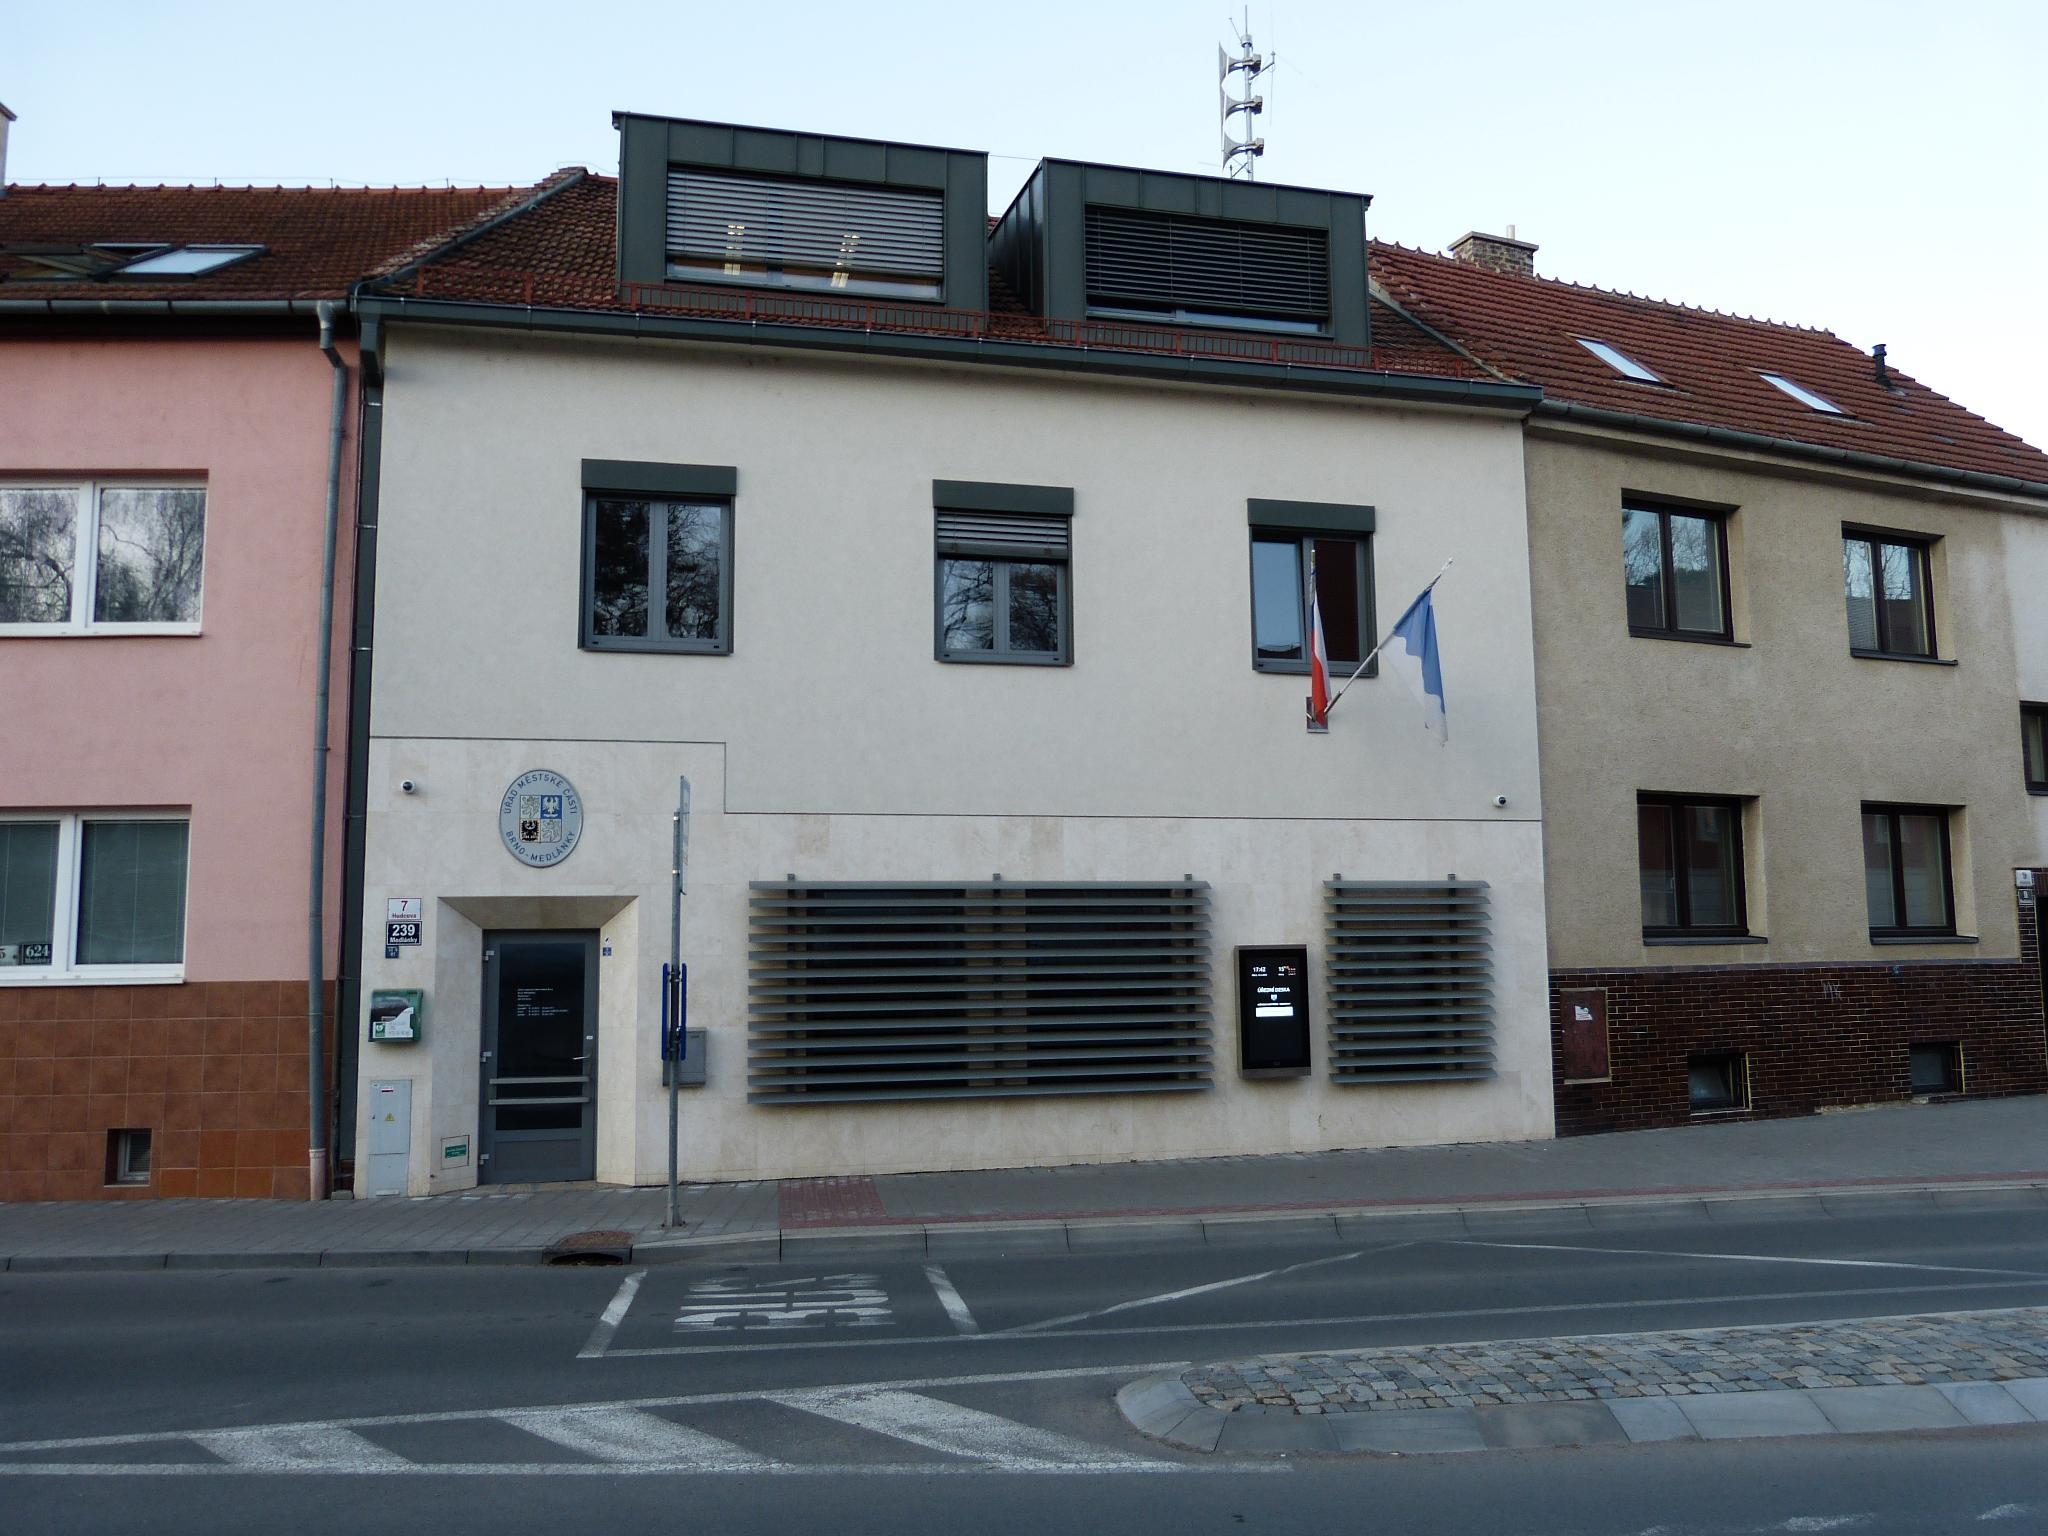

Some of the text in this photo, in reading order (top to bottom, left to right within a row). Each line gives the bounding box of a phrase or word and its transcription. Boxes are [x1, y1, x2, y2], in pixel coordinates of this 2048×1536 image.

[401, 900, 408, 911] 7
[392, 924, 416, 937] 239
[26, 944, 49, 957] 624
